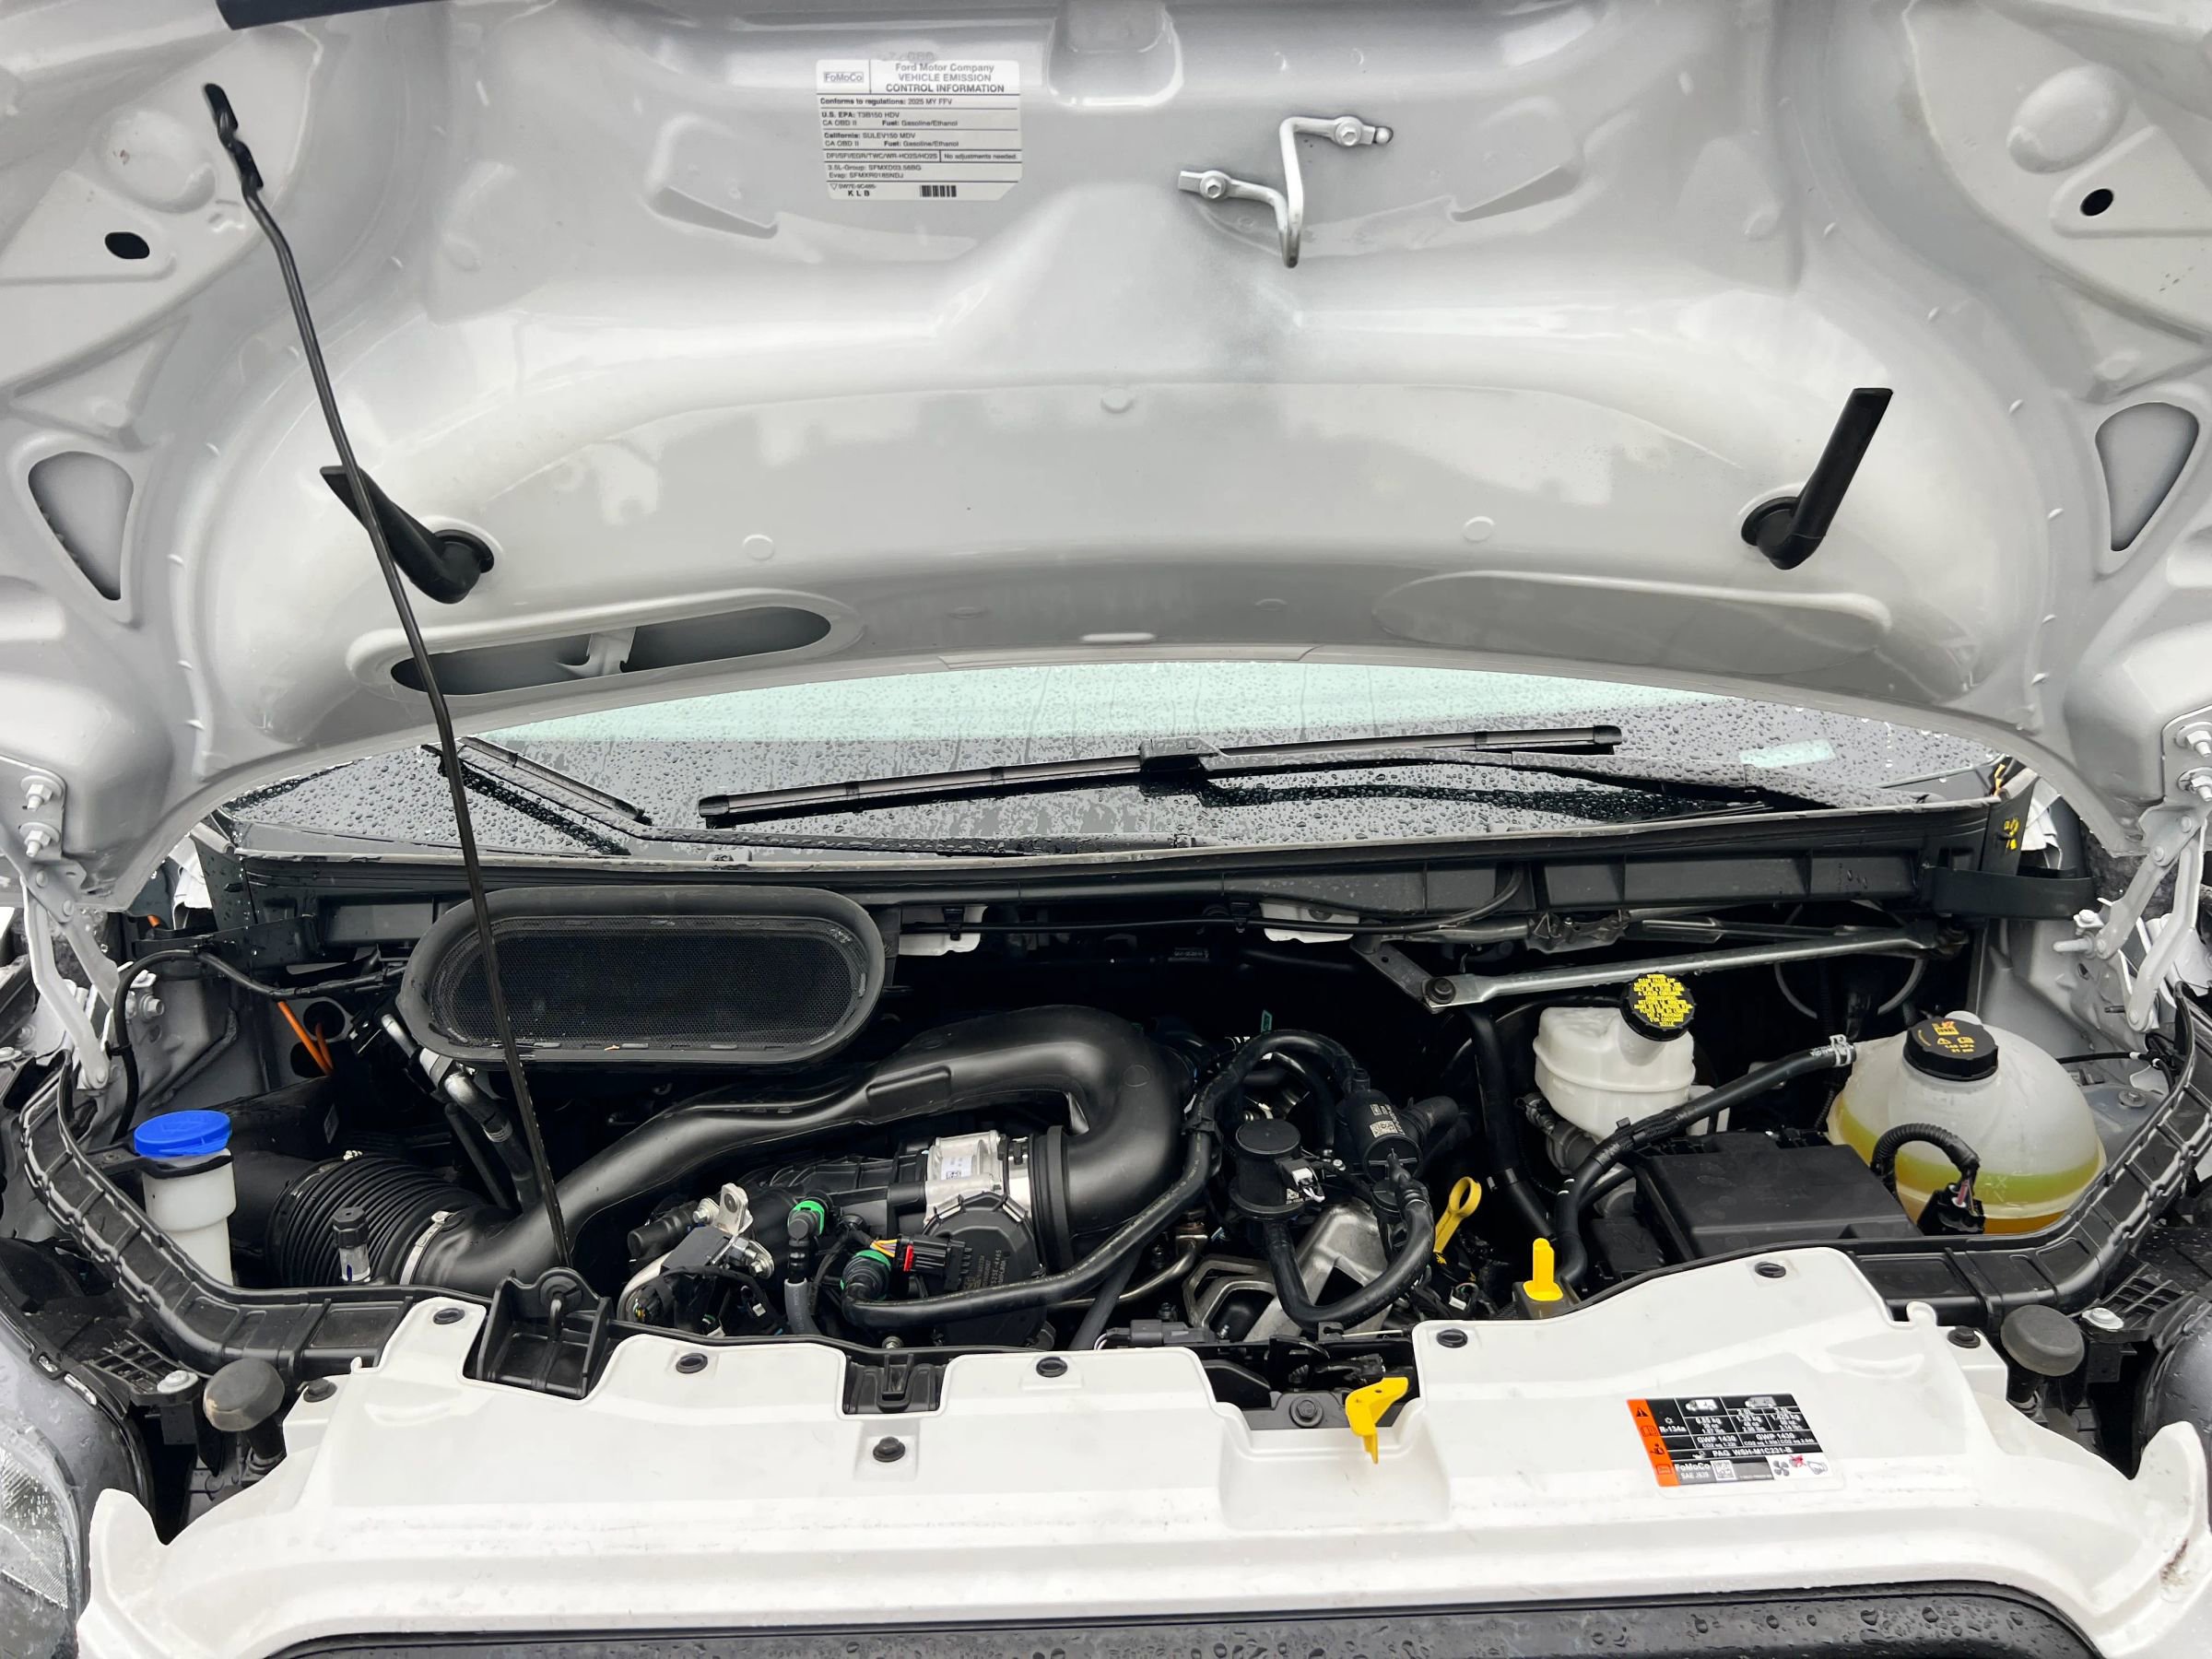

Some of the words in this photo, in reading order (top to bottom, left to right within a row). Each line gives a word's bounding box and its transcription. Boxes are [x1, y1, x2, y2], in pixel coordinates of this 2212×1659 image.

[895, 63, 917, 72] Ford
[920, 63, 947, 72] Motor
[949, 63, 994, 73] Company
[825, 73, 864, 82] FoMoCo
[899, 73, 940, 82] VEHICLE
[943, 73, 992, 82] EMISSION
[886, 84, 934, 92] CONTROL
[936, 84, 1005, 92] INFORMATION
[865, 98, 906, 106] regulations:
[1711, 1417, 1723, 1425] kg
[1751, 1415, 1762, 1423] kg
[1789, 1413, 1800, 1421] kg
[1712, 1449, 1730, 1457] PAG
[1732, 1447, 1794, 1456] WSH-M1C231-B
[1674, 1462, 1712, 1471] FoMoCo
